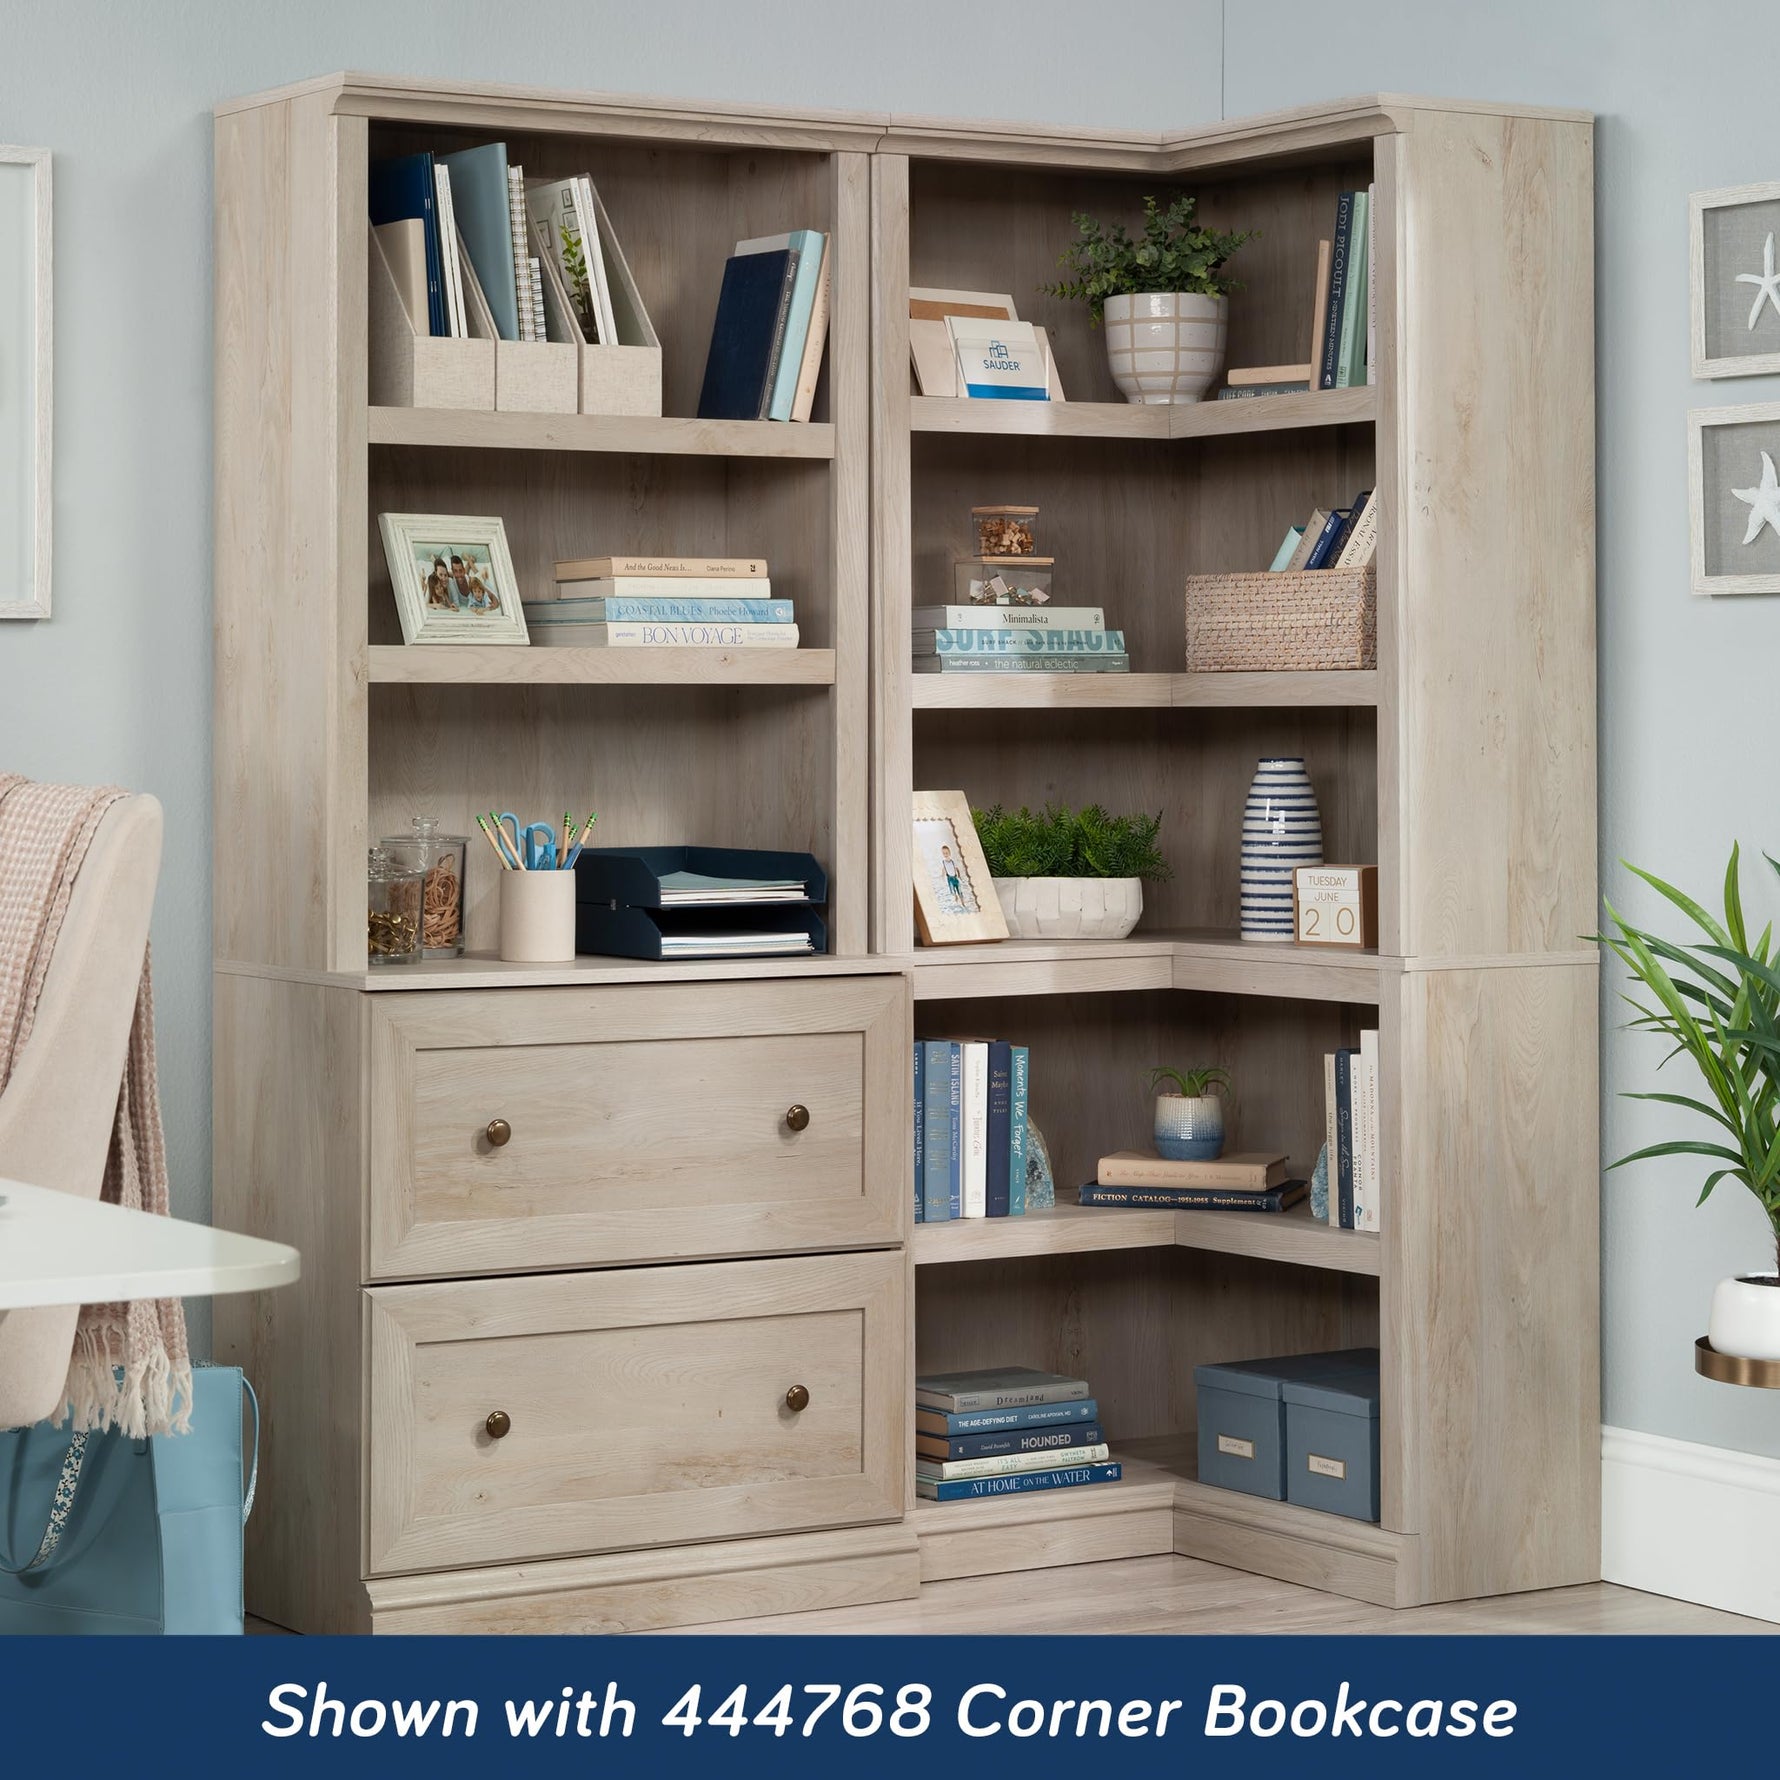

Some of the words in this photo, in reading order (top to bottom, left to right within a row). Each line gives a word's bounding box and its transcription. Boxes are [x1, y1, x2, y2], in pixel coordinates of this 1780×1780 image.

[1338, 196, 1350, 229] JODI
[1332, 235, 1346, 298] PICOULT
[1329, 300, 1338, 338] NINETEEN
[1325, 338, 1335, 370] MINUTES
[983, 359, 1021, 371] SAUDER
[1359, 504, 1377, 538] RSONAL
[1344, 540, 1360, 567] ESSAY
[624, 563, 636, 571] And
[637, 563, 646, 571] the
[617, 605, 666, 616] COASTAL
[669, 606, 702, 616] BLUES
[709, 606, 737, 616] Phoebe
[738, 606, 769, 616] Howard
[1002, 613, 1049, 625] Minimalista
[642, 626, 678, 644] BON
[681, 627, 743, 644] VOYAGE
[937, 629, 1012, 651] SURF
[949, 659, 968, 667] heather
[994, 658, 1009, 669] the
[1012, 658, 1042, 669] natural
[1045, 659, 1079, 669] eclectic
[1308, 875, 1347, 887] TUESDAY
[1314, 892, 1340, 902] JUNE
[951, 1054, 960, 1076] SATIN
[1015, 1055, 1027, 1097] Moments
[950, 1077, 960, 1106] ISLAND
[1014, 1101, 1025, 1120] We
[1011, 1125, 1024, 1158] Forget
[1092, 1193, 1128, 1201] FICTION
[1212, 1196, 1256, 1206] Supplement
[996, 1393, 1044, 1406] Dreamland
[958, 1420, 969, 1428] THE
[969, 1417, 1005, 1427] AGE-DEFYING
[1005, 1415, 1018, 1423] DIET
[1021, 1433, 1071, 1449] HOUNDED
[971, 1481, 986, 1494] AT
[987, 1477, 1021, 1493] HOME
[1035, 1475, 1049, 1485] THE
[1051, 1469, 1090, 1485] WATER
